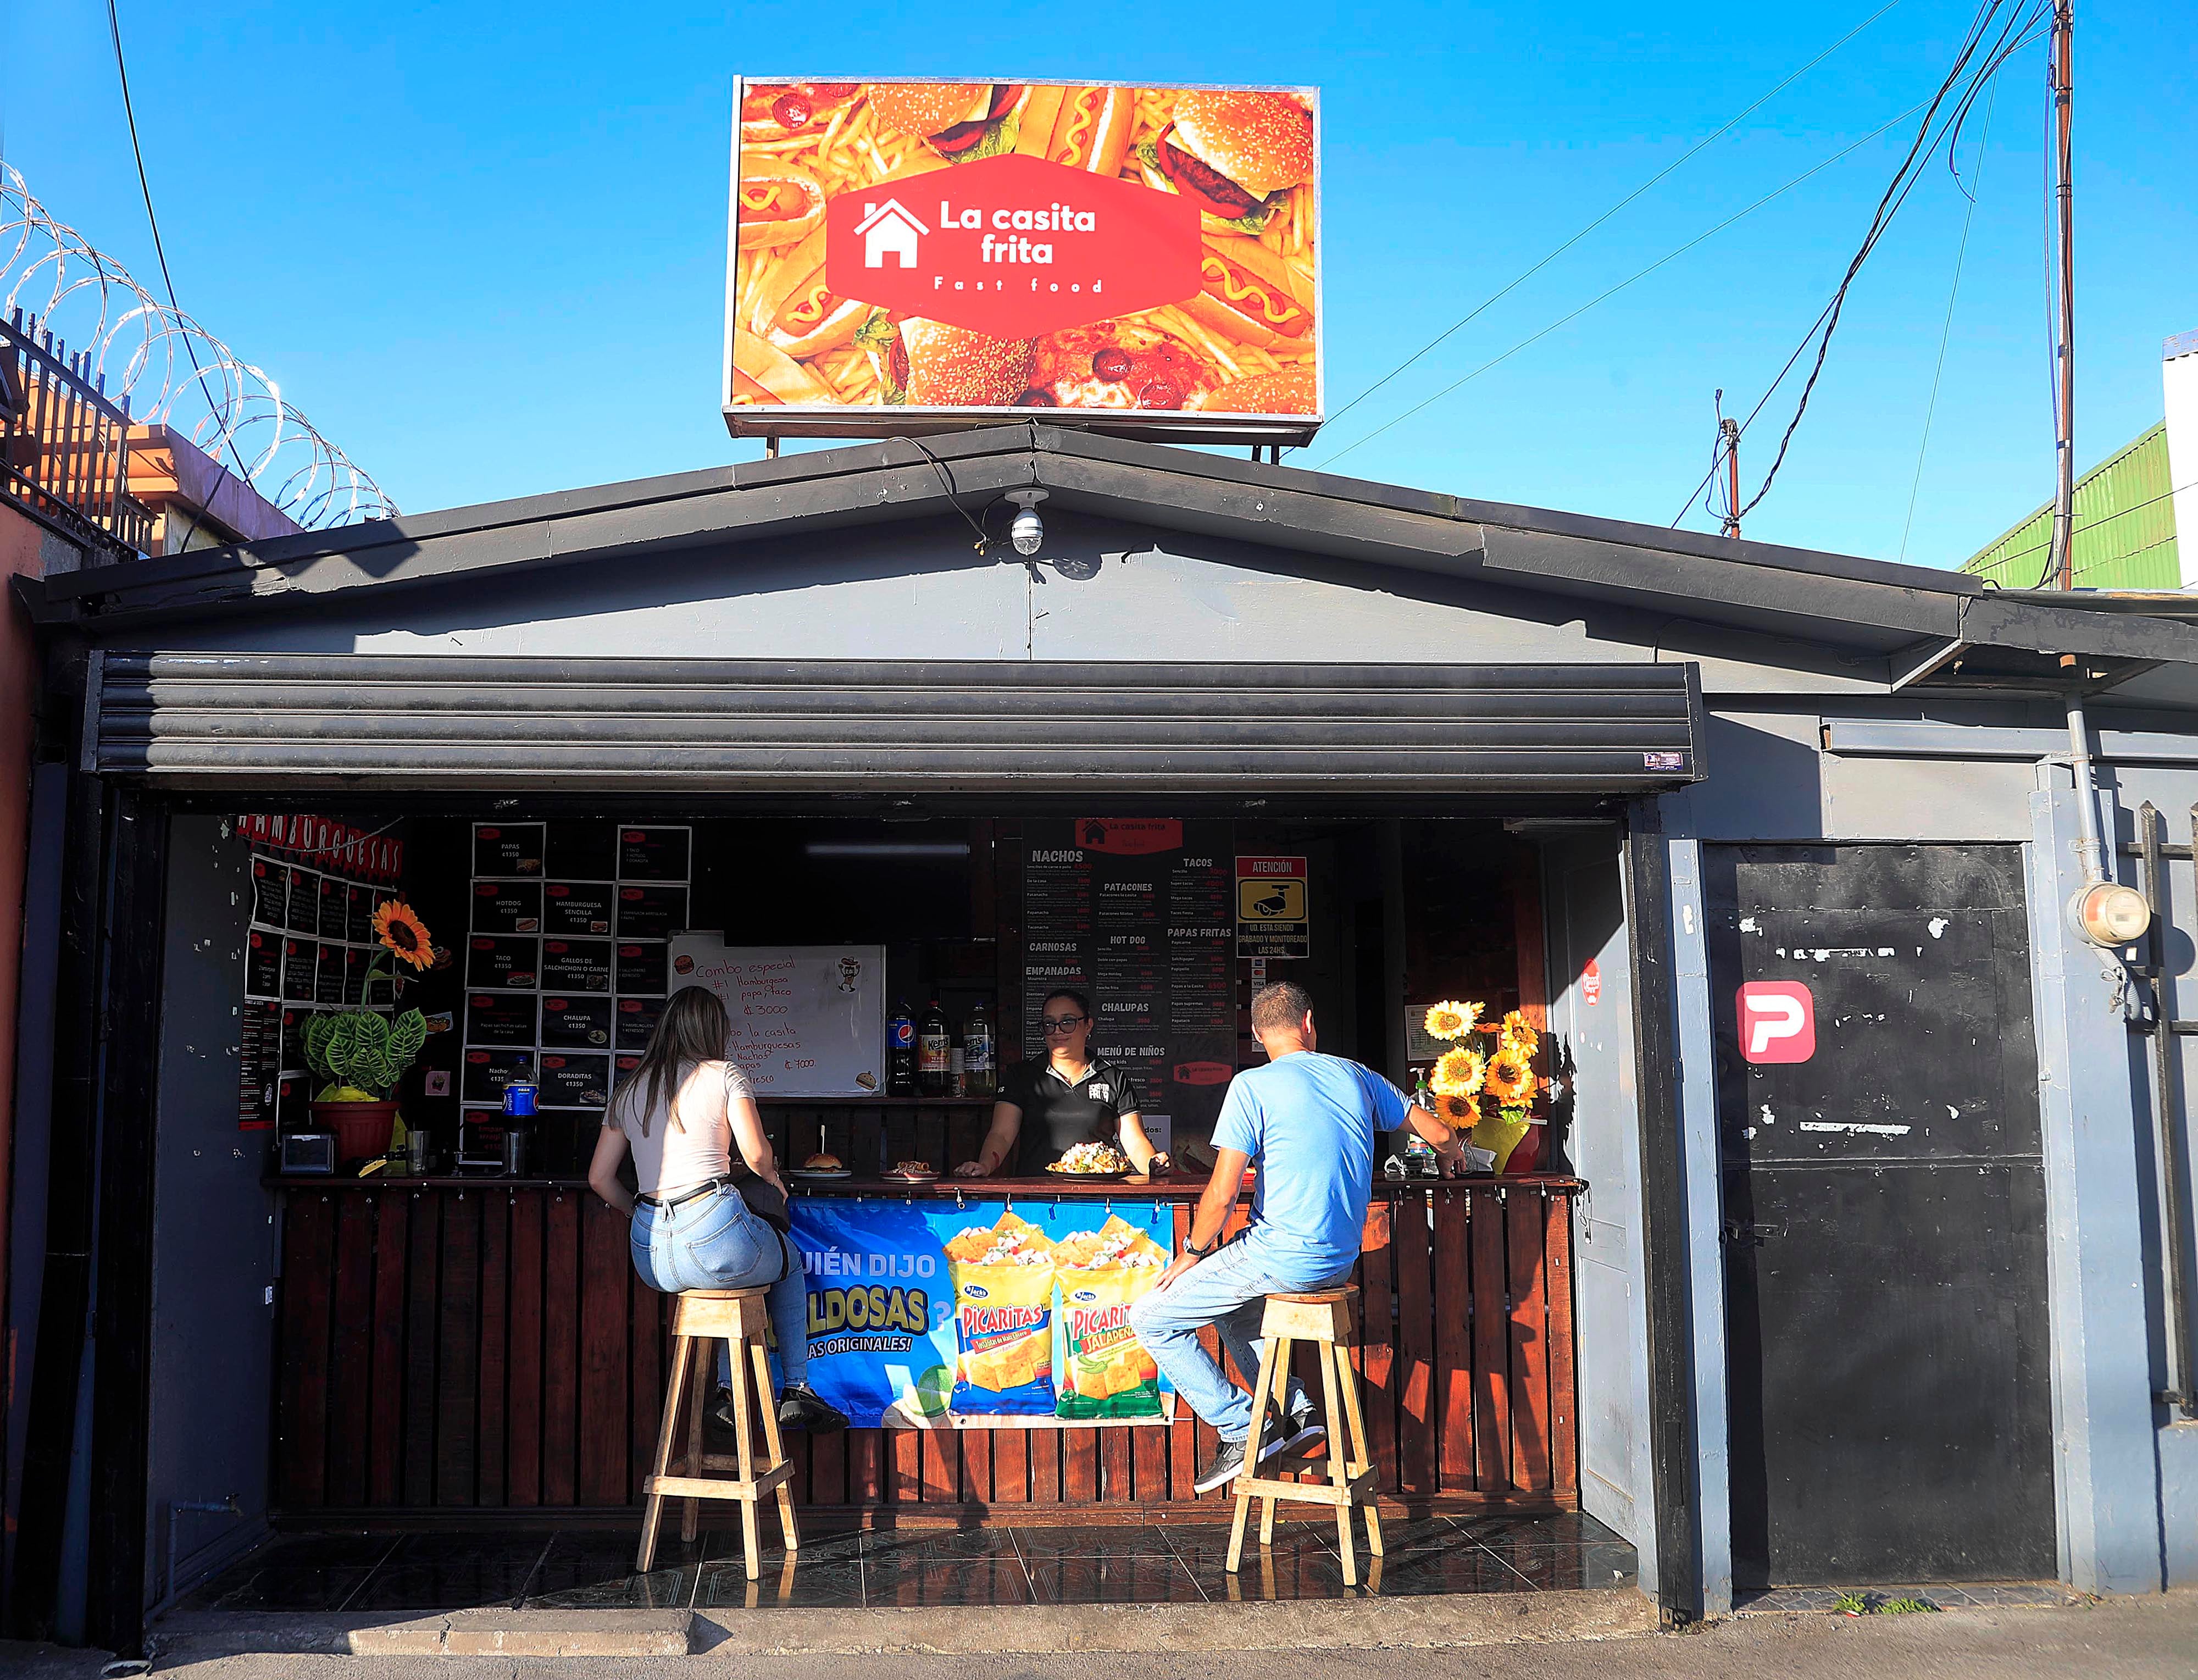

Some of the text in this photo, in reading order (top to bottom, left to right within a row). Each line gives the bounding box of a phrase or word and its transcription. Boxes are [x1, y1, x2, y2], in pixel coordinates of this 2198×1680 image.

[940, 200, 1096, 232] La casita
[981, 234, 1053, 265] frita
[934, 276, 1102, 293] Fast food
[1033, 850, 1084, 862] NACHOS
[1183, 858, 1213, 867] TACOS
[1252, 859, 1292, 873] ATENCIÓN
[1168, 929, 1231, 937] PAPAS FRITAS
[1250, 923, 1259, 932] UD.
[1274, 923, 1294, 932] SIENDO
[1110, 936, 1146, 944] HOT DOG
[1238, 935, 1264, 943] GRABADO
[1269, 935, 1308, 943] MONITOREADO
[1029, 942, 1077, 952] CARNOSAS
[1258, 946, 1269, 954] LAS
[696, 954, 796, 978] Combo especial
[1025, 967, 1081, 975] EMPANADAS
[1101, 1003, 1150, 1012] CHALUPAS
[765, 1022, 796, 1038] casita
[737, 1050, 769, 1061] Nachos
[1097, 1044, 1165, 1056] MENÚ DE NIÑOS
[737, 1062, 761, 1071] apas
[801, 1246, 936, 1278] UIÉN DIJO
[806, 1287, 926, 1334] LDOSAS
[807, 1337, 912, 1359] AS ORIGINALES!
